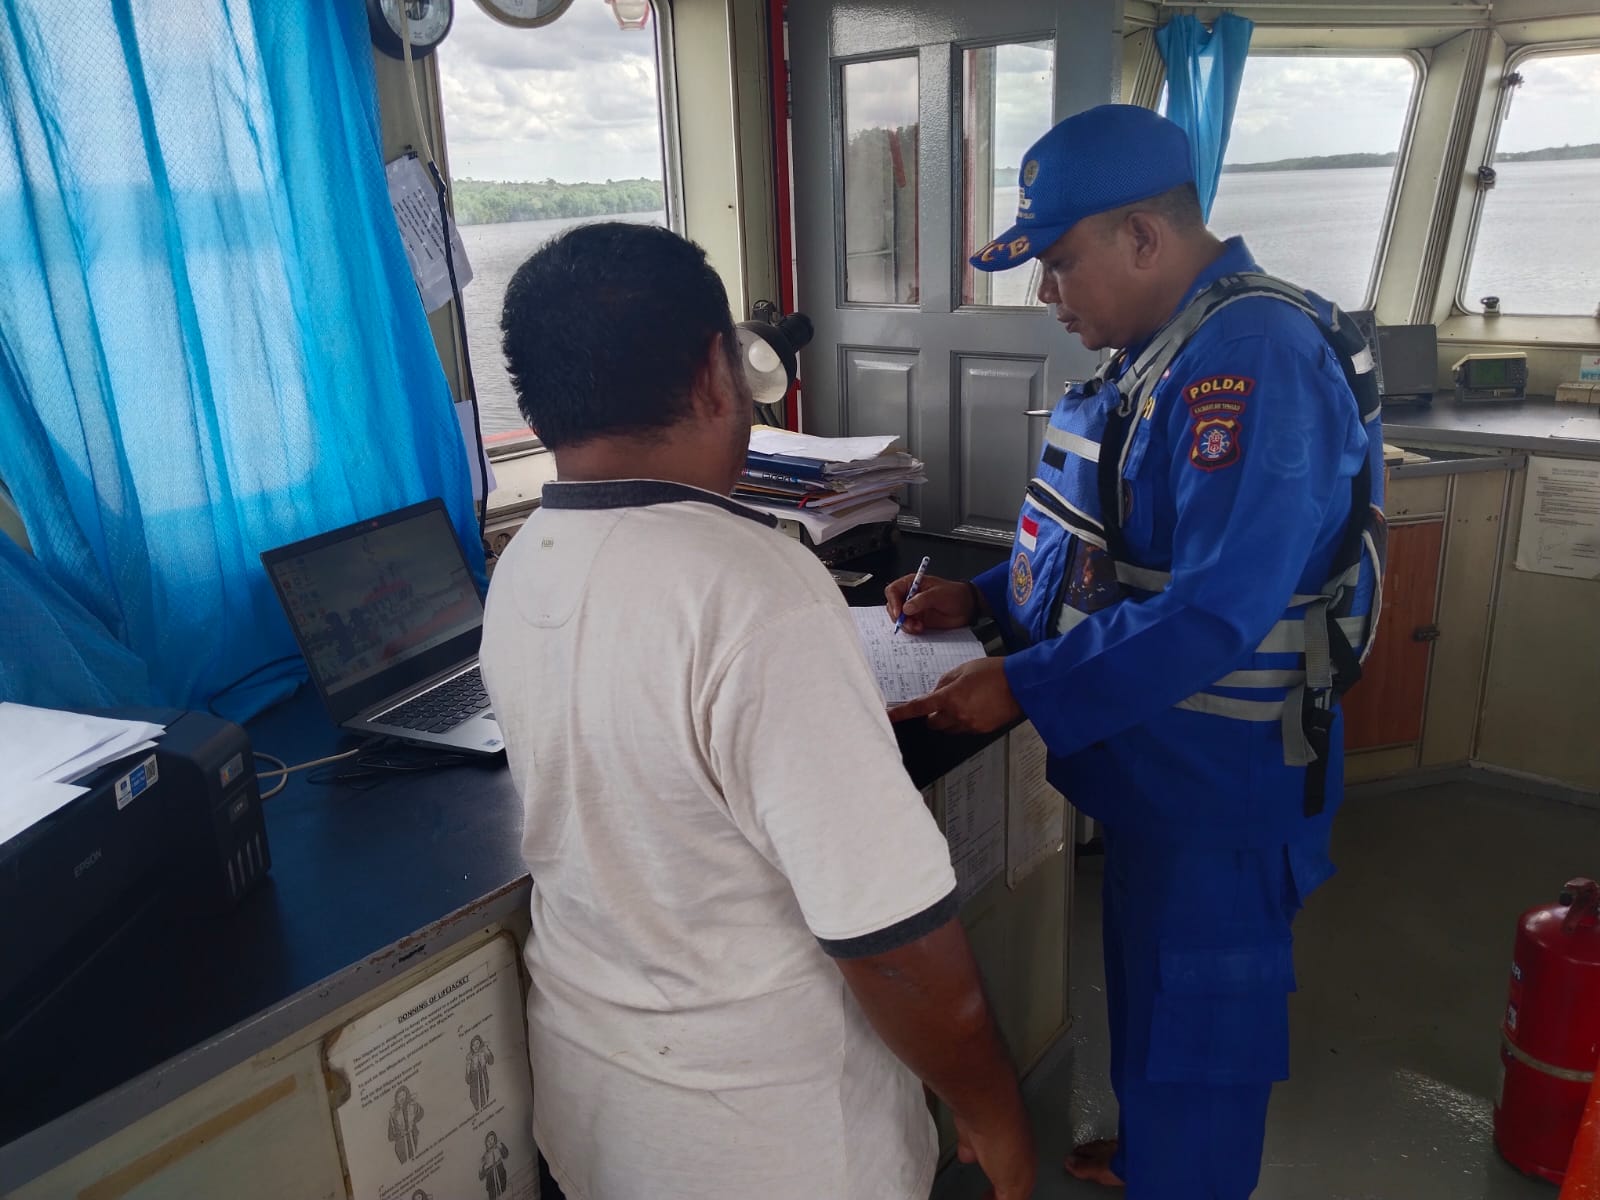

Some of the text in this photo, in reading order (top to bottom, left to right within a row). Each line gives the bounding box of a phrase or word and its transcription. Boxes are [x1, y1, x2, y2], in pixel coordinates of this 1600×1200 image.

[1189, 378, 1245, 399] POLDA
[73, 847, 102, 878] EPSON
[397, 1001, 428, 1024] DONNING
[437, 975, 469, 1000] LIFEJACKET
